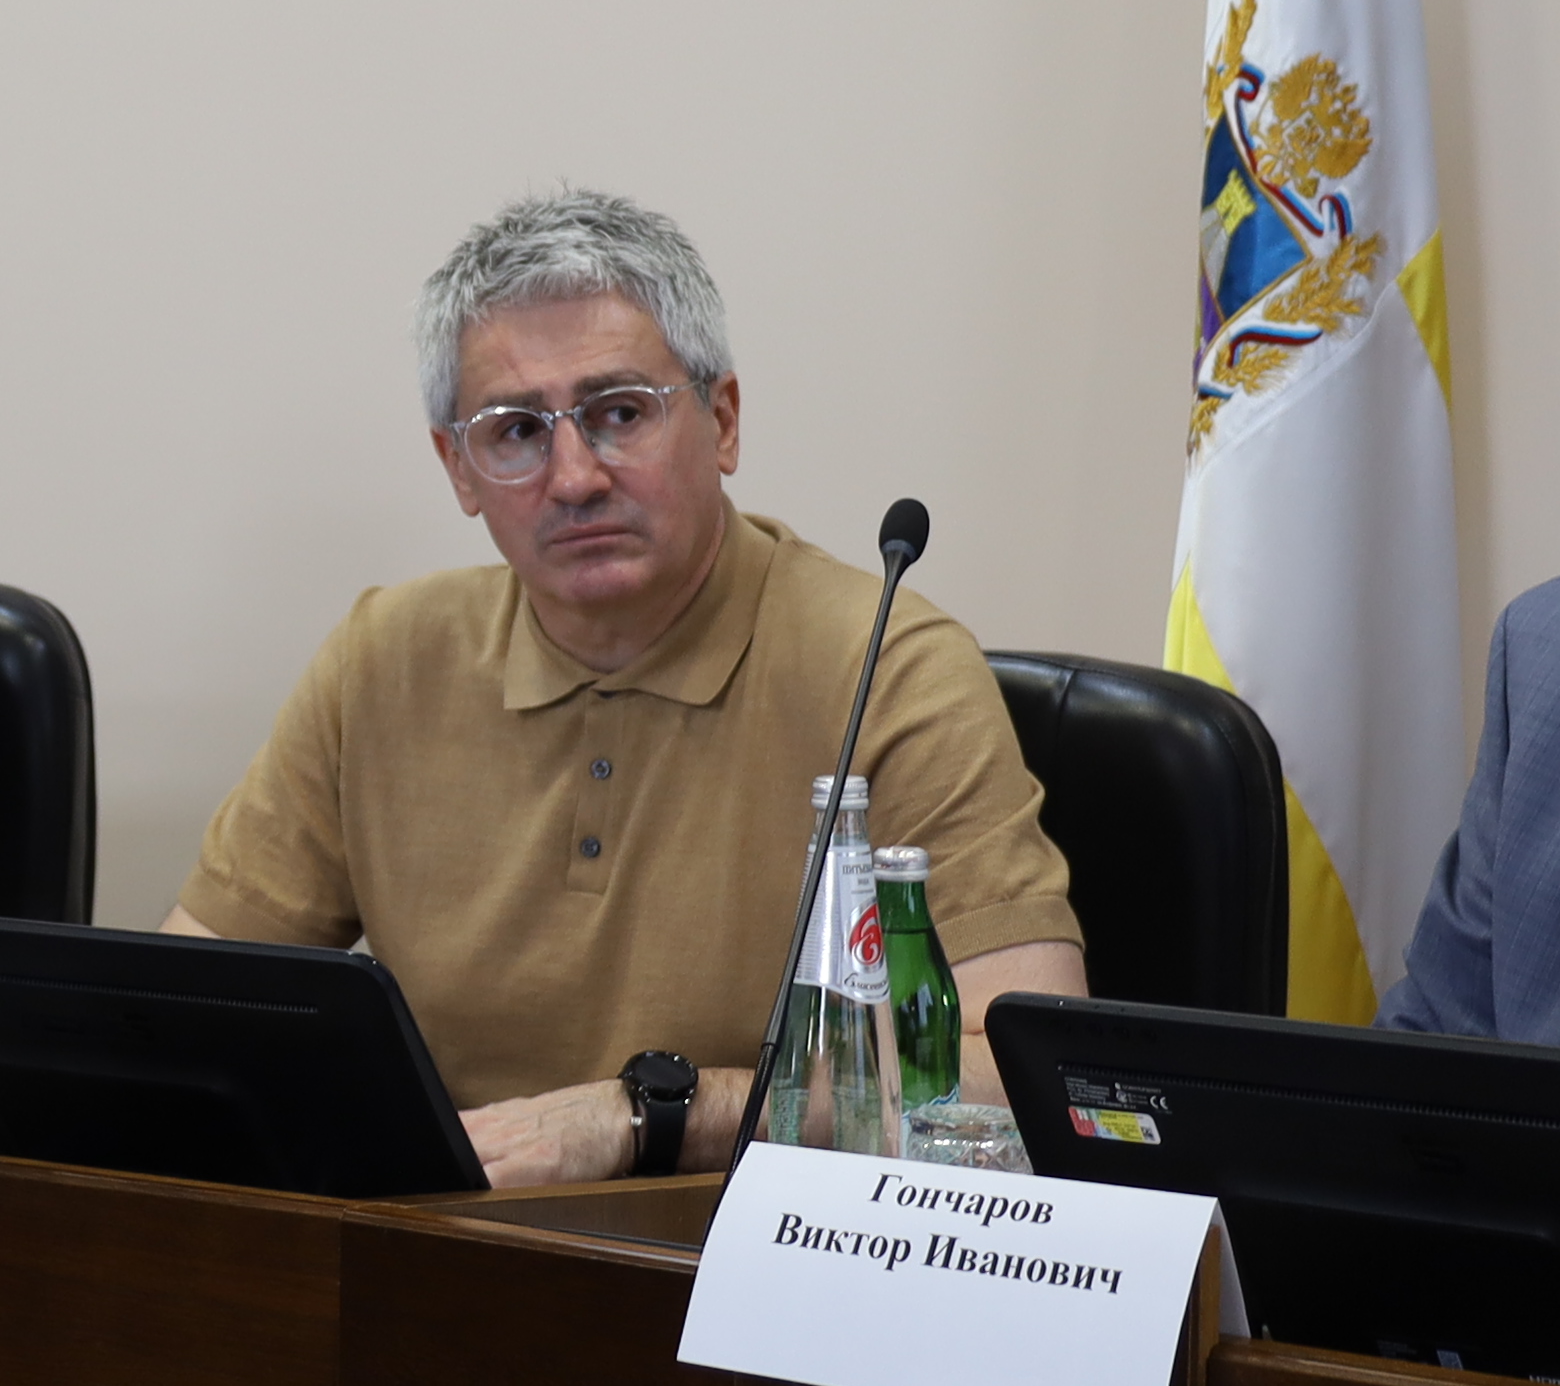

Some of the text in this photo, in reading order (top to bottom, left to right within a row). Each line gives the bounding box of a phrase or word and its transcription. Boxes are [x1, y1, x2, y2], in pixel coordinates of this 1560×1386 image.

[869, 1173, 1054, 1227] Гончаров
[772, 1212, 1123, 1295] Виктор Иванович
